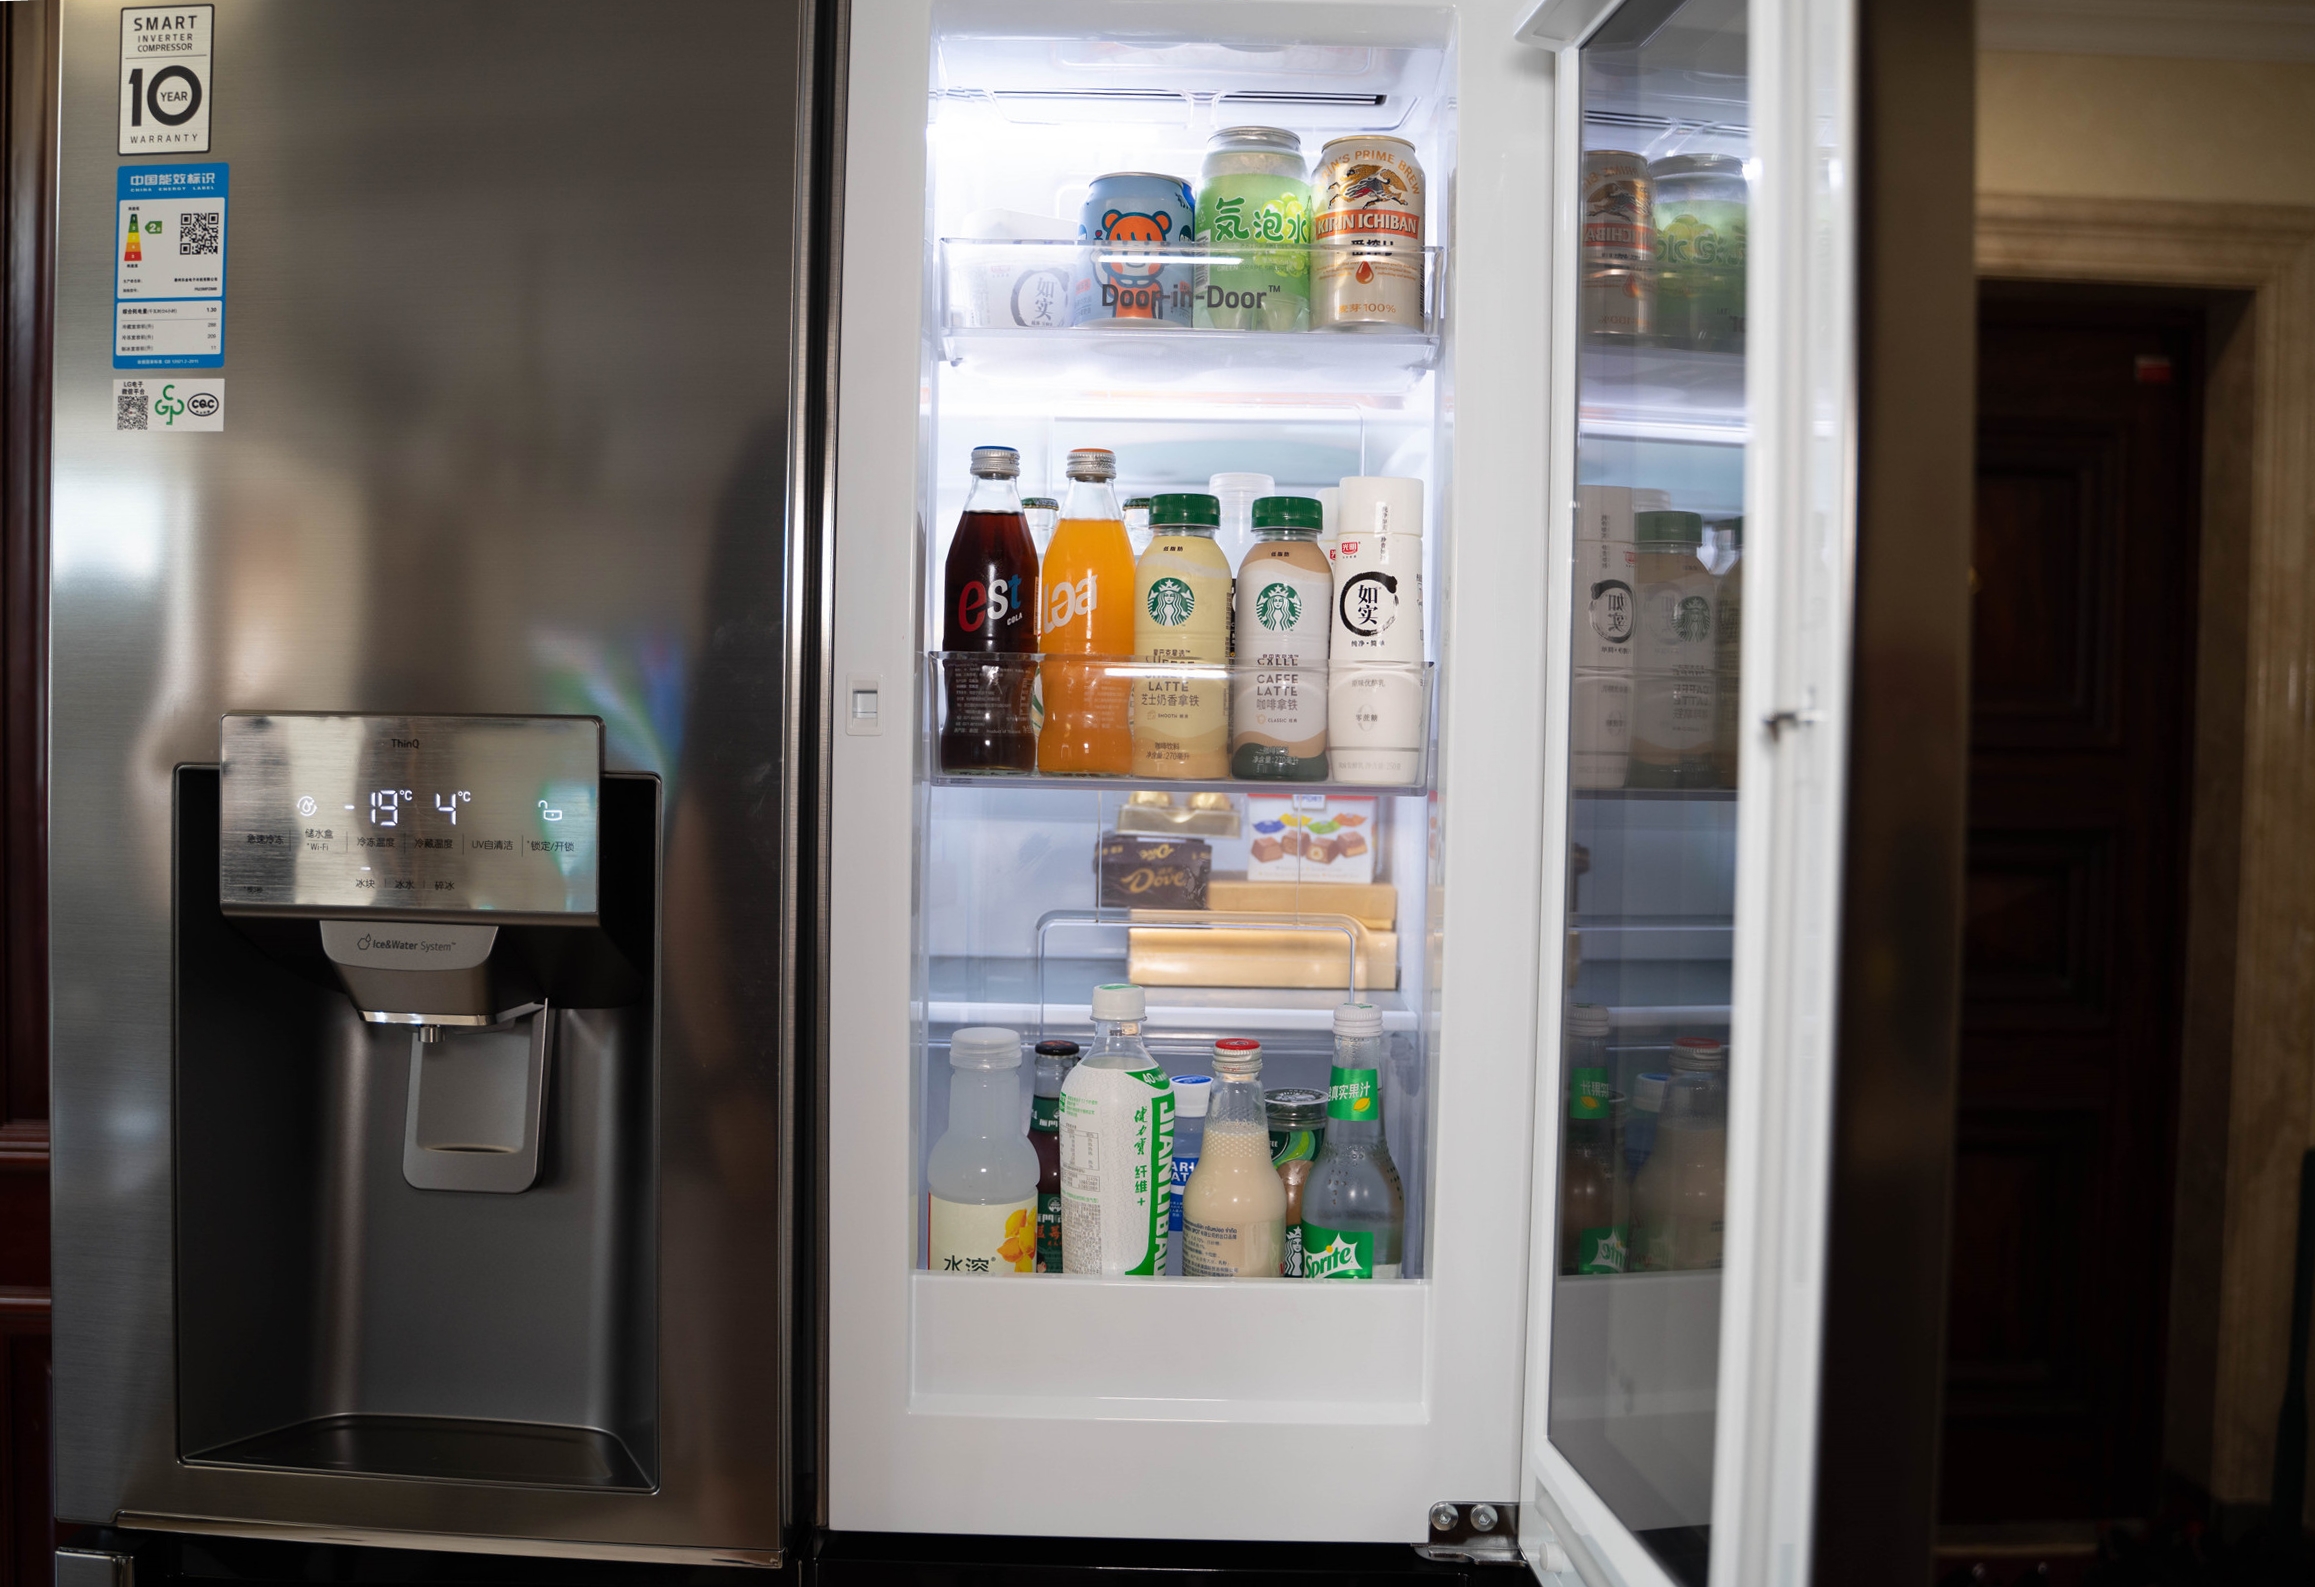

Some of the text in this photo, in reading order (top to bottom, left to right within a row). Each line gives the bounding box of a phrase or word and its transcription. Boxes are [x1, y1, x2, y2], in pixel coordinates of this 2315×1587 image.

[134, 15, 197, 31] SMART
[138, 33, 193, 42] INVERTER
[138, 43, 193, 52] COMPRESSOR
[129, 65, 202, 126] 10
[160, 91, 188, 101] YEAR
[130, 134, 198, 143] WARRANTY
[1355, 149, 1395, 164] PRIME
[1397, 159, 1420, 195] BREW
[130, 173, 215, 186] 中国能效标识
[1214, 197, 1308, 244] 気泡水
[1317, 212, 1417, 234] KIRIN ICHIBAN
[1034, 276, 1055, 321] 如实
[191, 399, 215, 409] CQC
[1343, 543, 1357, 552] 光明
[959, 574, 1021, 632] est
[1357, 584, 1379, 626] 如实
[1007, 613, 1023, 626] COLA
[1148, 682, 1189, 691] LATTE
[1257, 686, 1298, 696] LATTE
[1141, 694, 1200, 707] 芝士奶香拿铁
[1257, 698, 1298, 711] 咖啡拿铁
[391, 739, 420, 750] ThinQ
[247, 834, 284, 845] 急速冷冻
[305, 829, 334, 839] 储水盒
[357, 837, 395, 848] 冷冻温度
[414, 838, 453, 849] 冷藏温度
[472, 840, 513, 850] UV自清洁
[355, 879, 375, 889] 冰块
[395, 880, 415, 889] 冰水
[435, 881, 455, 891] 碎冰
[1121, 868, 1186, 893] Dove
[373, 939, 418, 950] Ice&Water
[1305, 1246, 1351, 1279] Sprite
